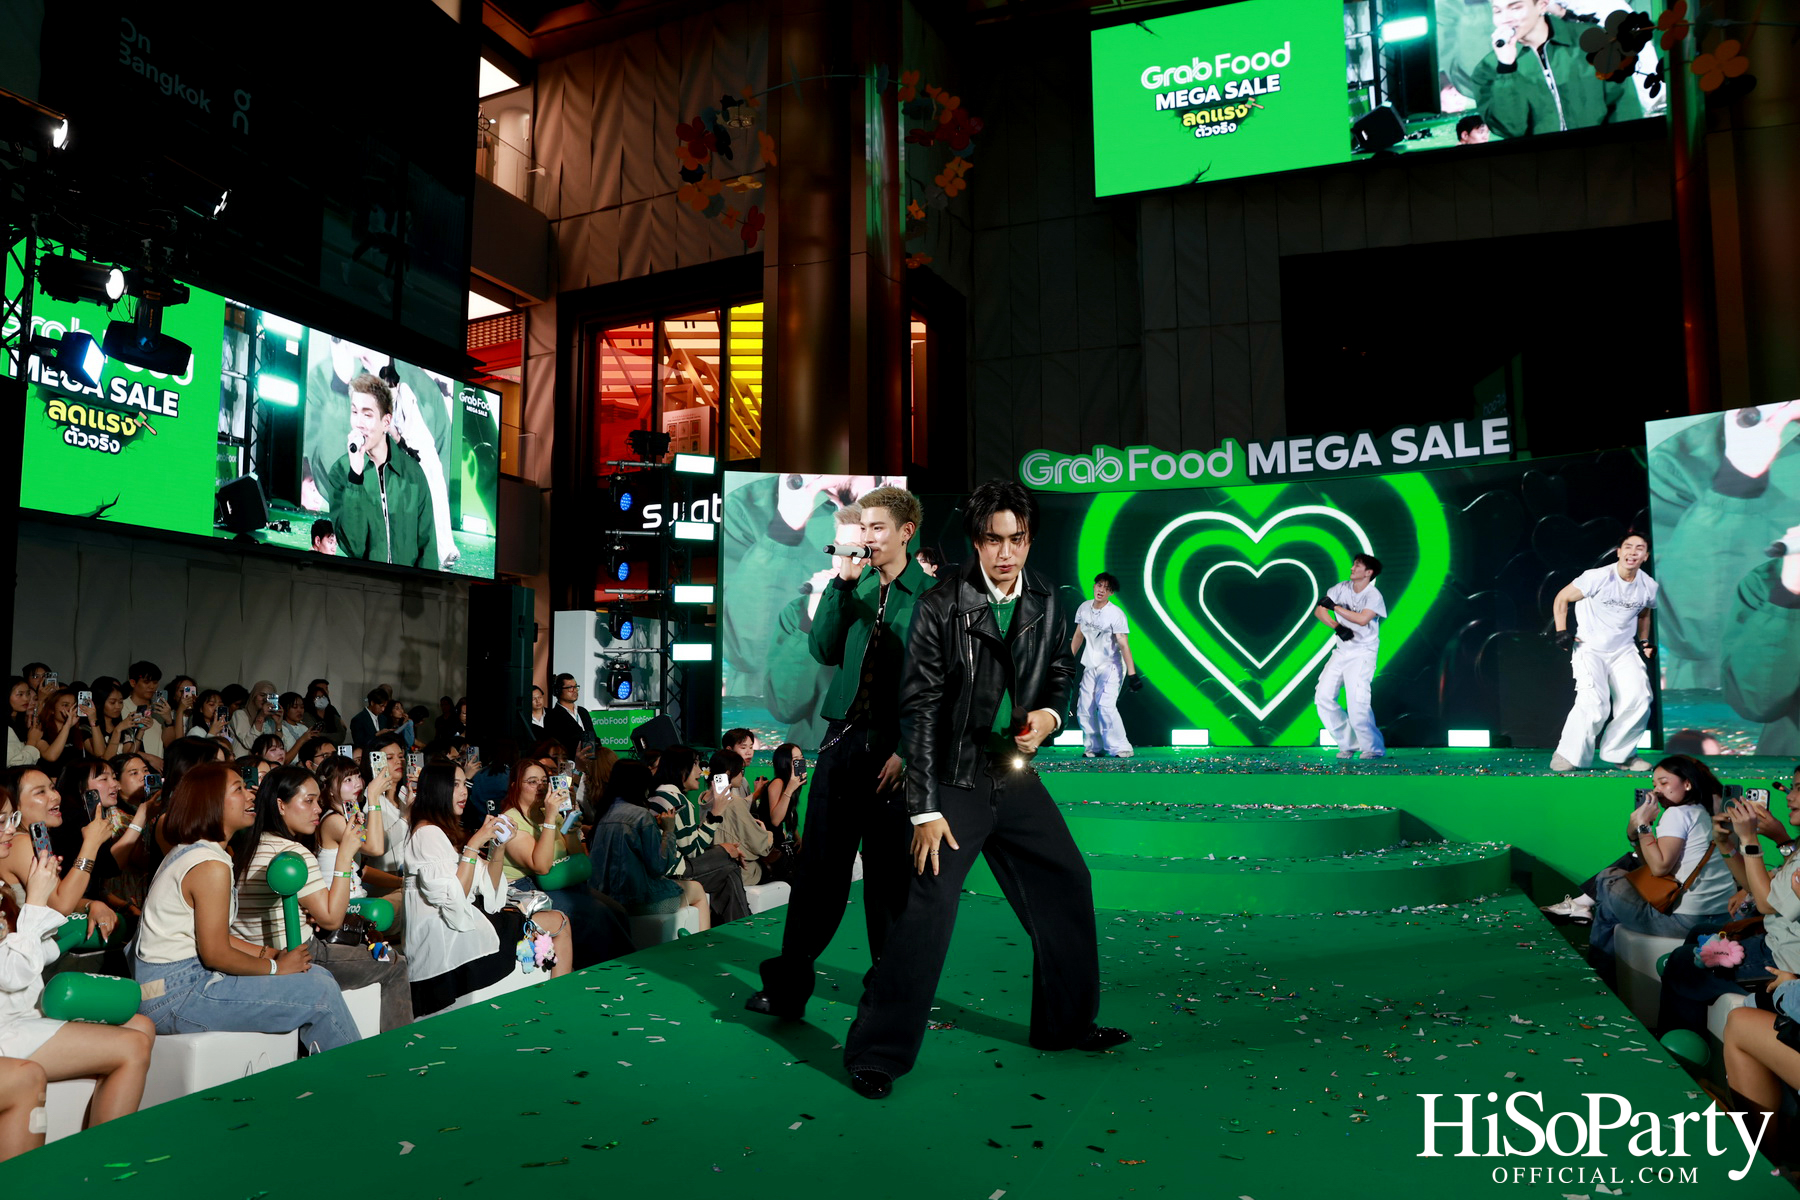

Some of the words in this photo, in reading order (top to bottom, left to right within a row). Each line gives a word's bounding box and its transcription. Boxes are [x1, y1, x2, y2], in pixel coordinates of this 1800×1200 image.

[1156, 85, 1221, 111] MEGA
[1224, 74, 1281, 100] SALE
[1182, 104, 1248, 127] ลดแรง
[1195, 121, 1237, 138] ตัวจริง
[110, 377, 179, 417] SALE
[459, 391, 490, 411] GrabFoo
[48, 400, 137, 436] ลดแรง
[64, 425, 120, 453] ตัวจริง
[1248, 433, 1382, 476] MEGA
[1391, 417, 1510, 464] SALE
